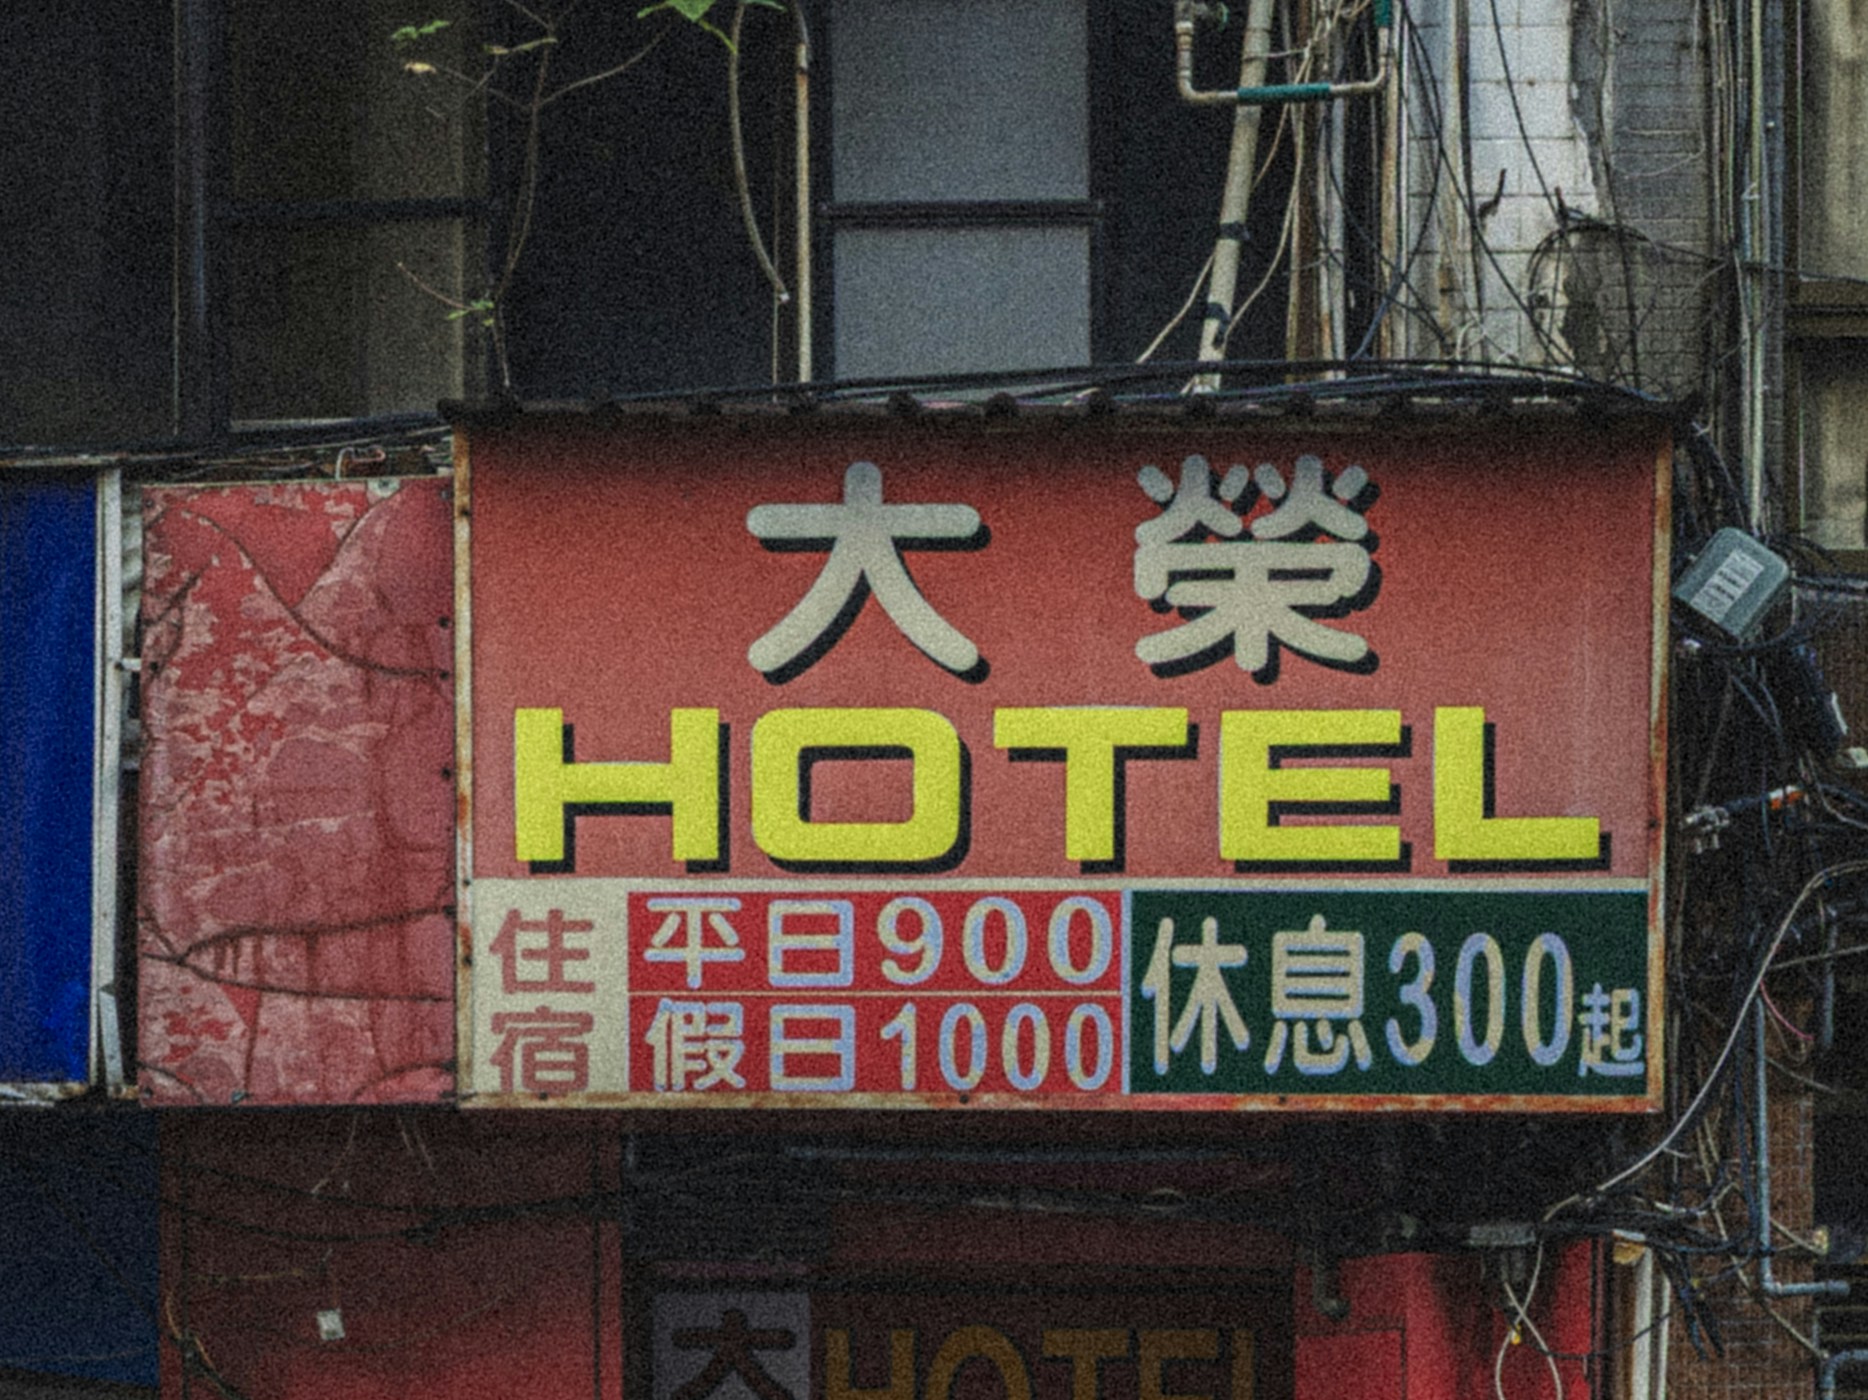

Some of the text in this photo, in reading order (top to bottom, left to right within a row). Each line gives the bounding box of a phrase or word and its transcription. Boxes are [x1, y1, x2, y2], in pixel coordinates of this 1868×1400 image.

[745, 455, 1381, 686] 大榮
[513, 706, 1609, 873] HOTEL
[488, 907, 596, 1093] 住宿
